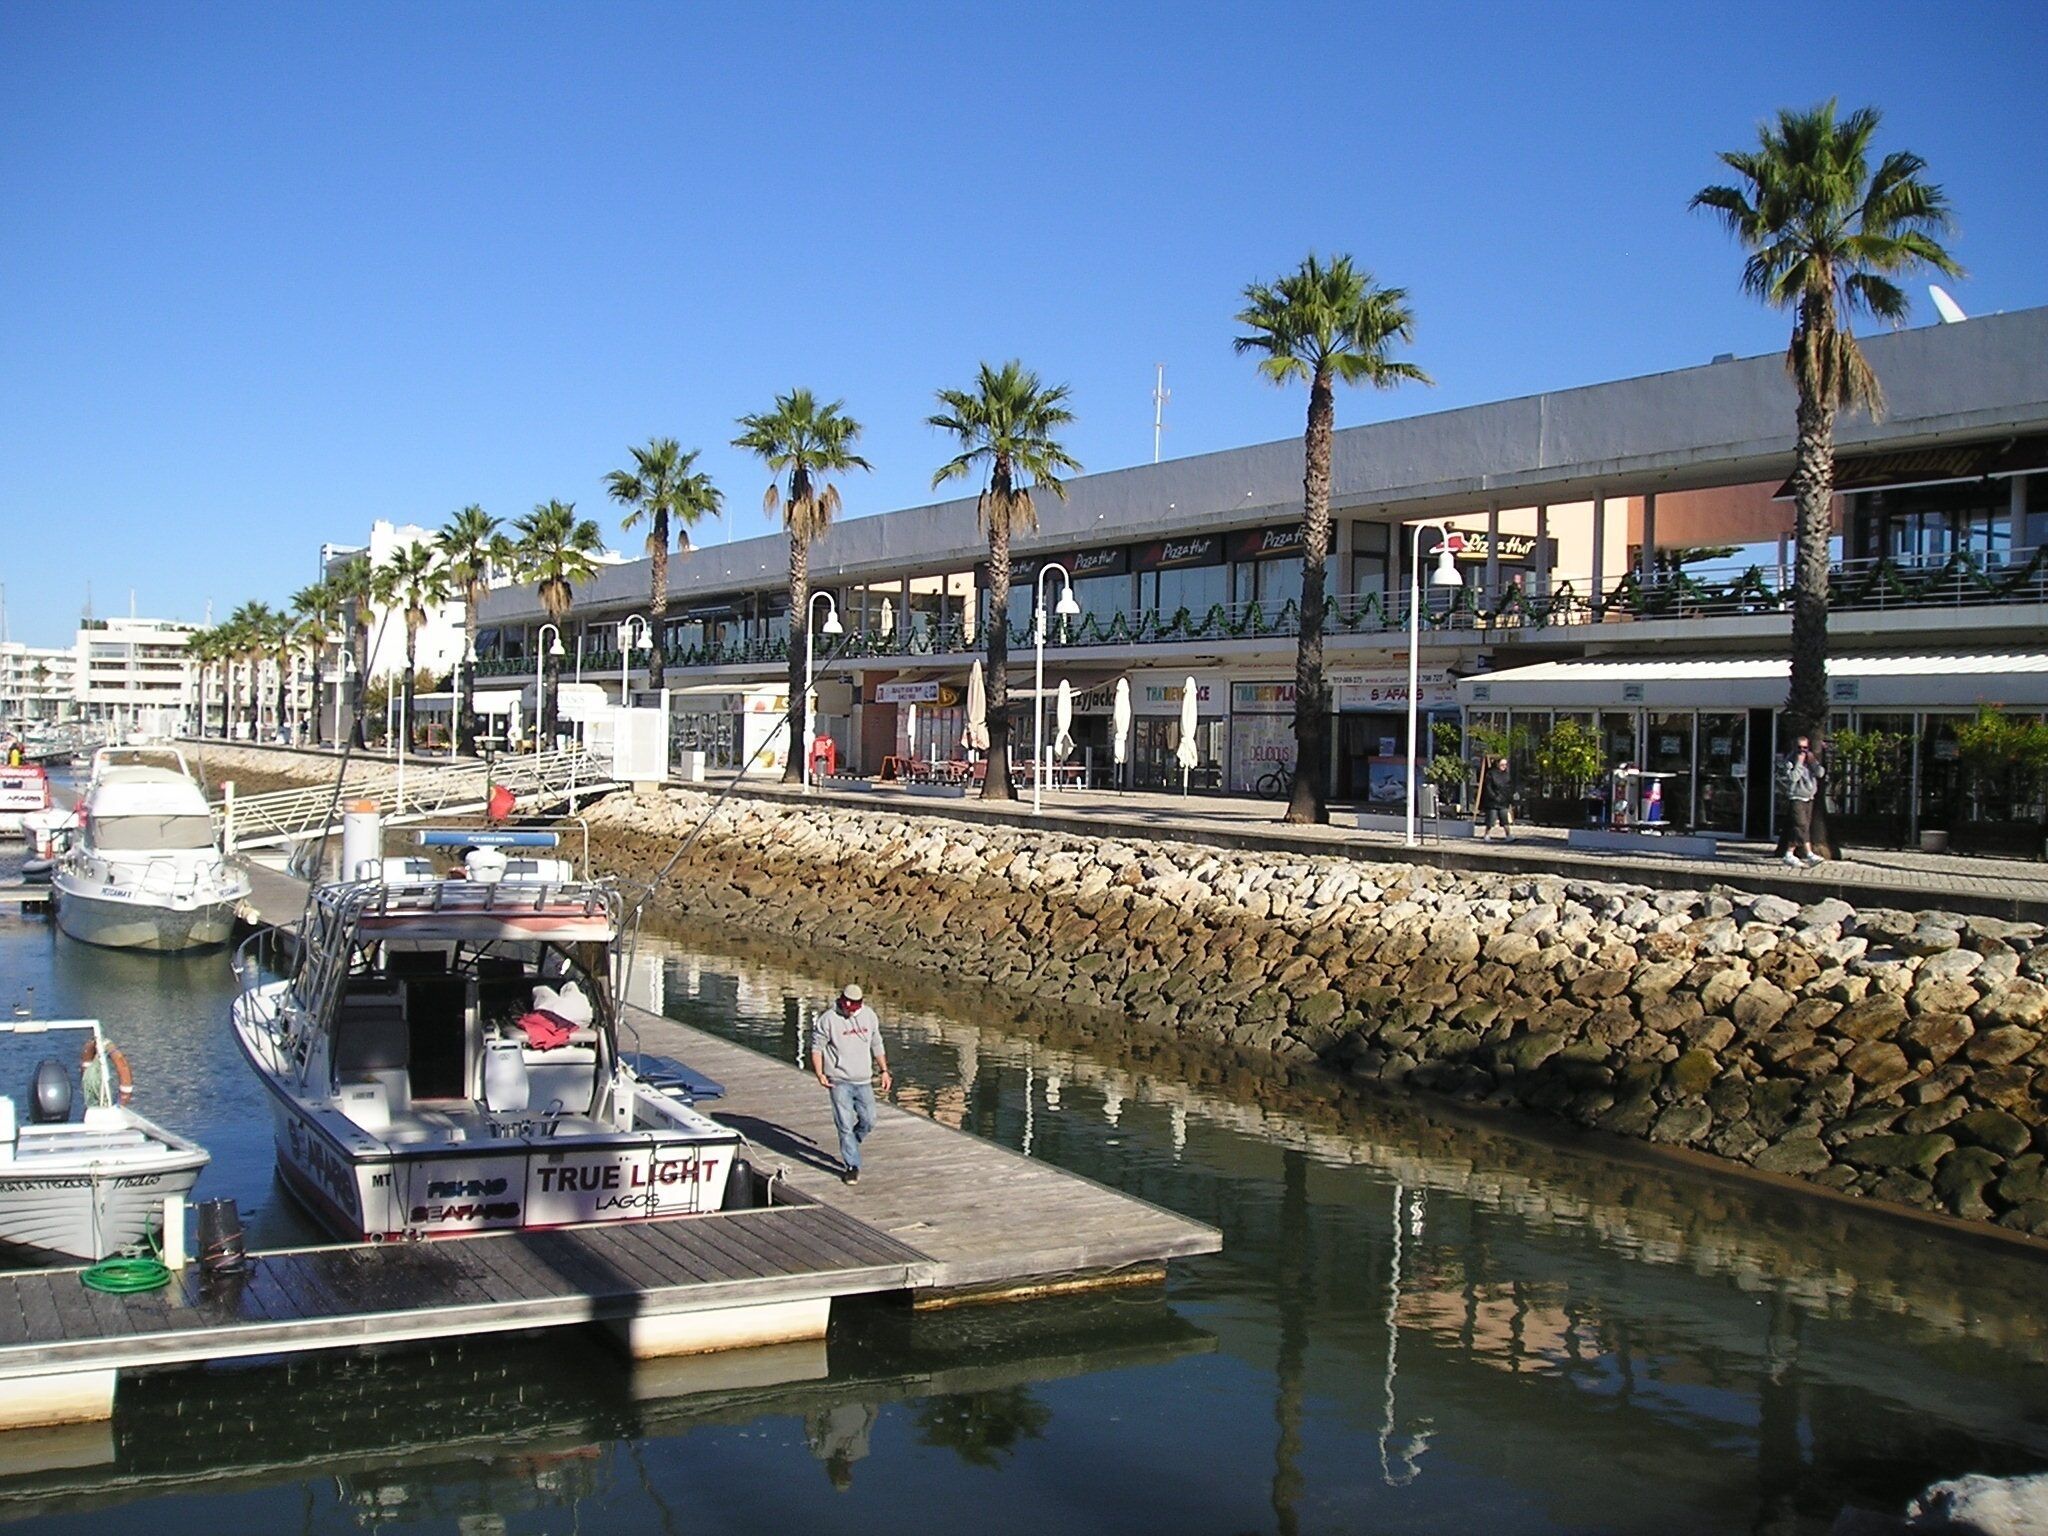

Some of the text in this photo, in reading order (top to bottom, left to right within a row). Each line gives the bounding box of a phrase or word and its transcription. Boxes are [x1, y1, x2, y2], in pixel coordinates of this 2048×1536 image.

[1506, 536, 1537, 553] Hut
[372, 1173, 391, 1188] MT
[537, 1159, 720, 1192] TRUE LIGHT
[595, 1193, 660, 1211] LAGOS
